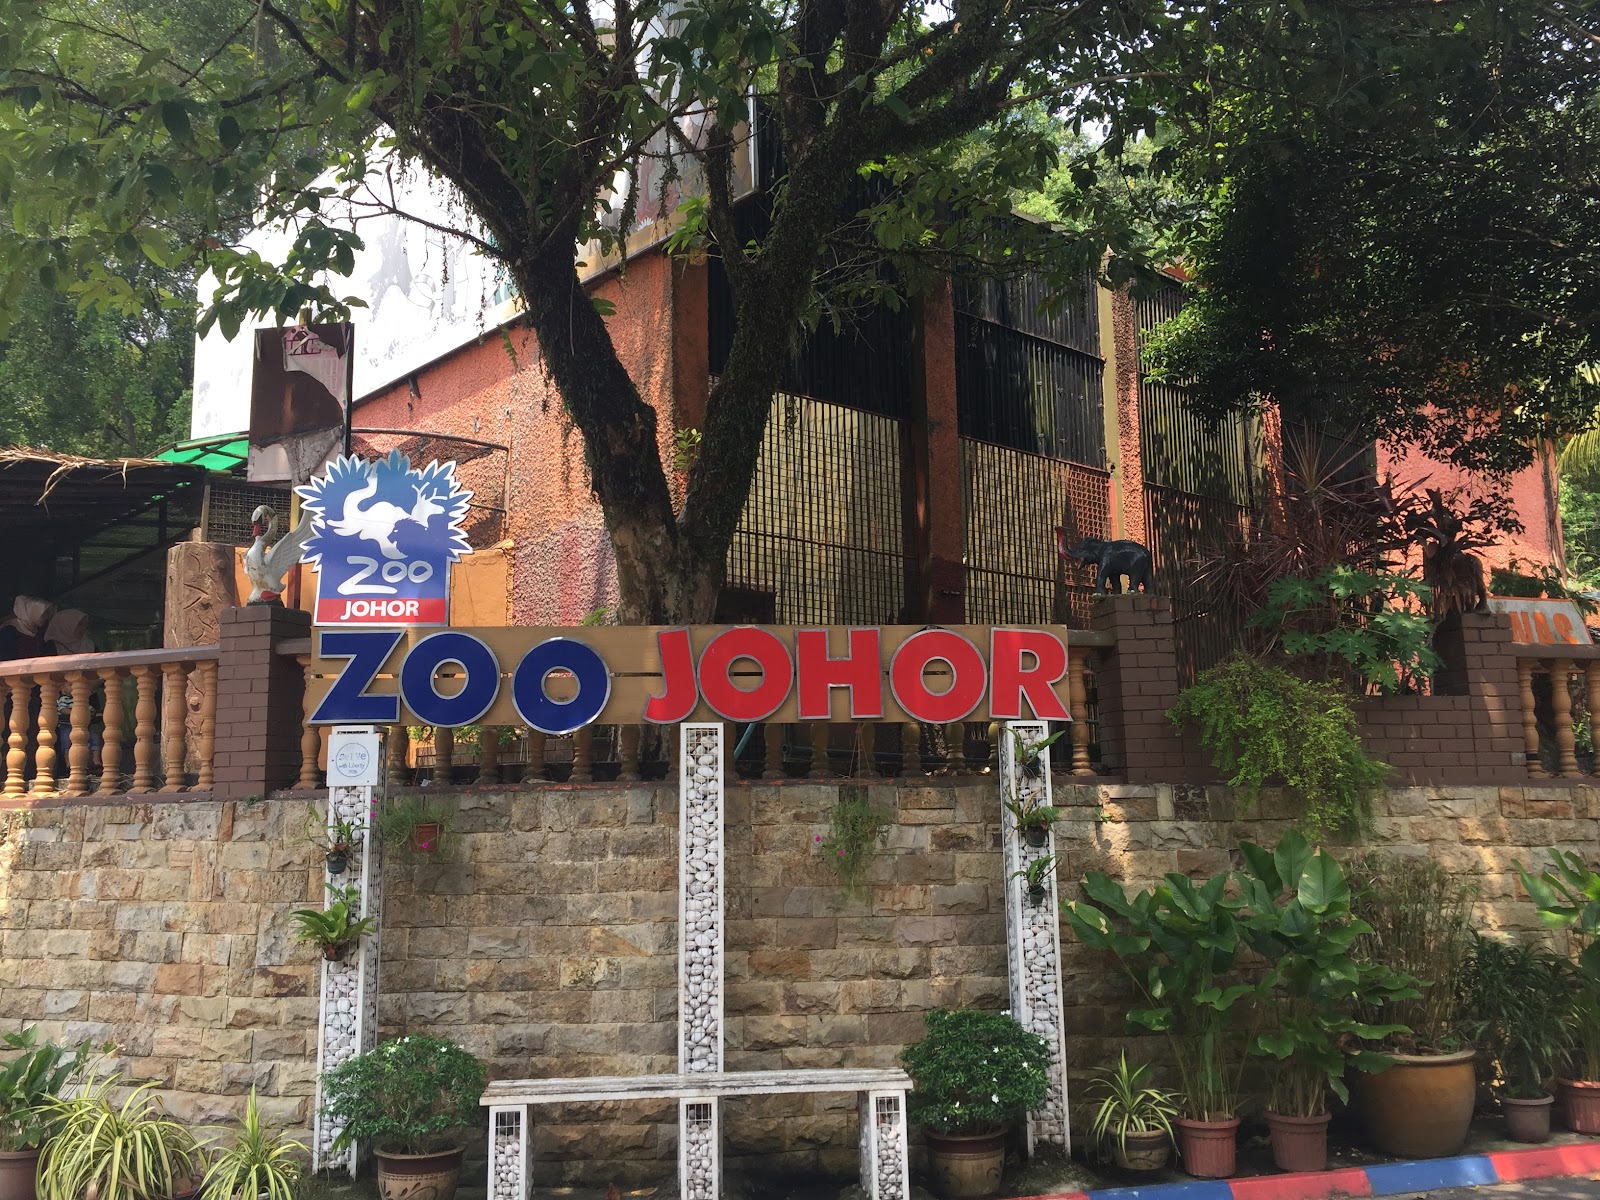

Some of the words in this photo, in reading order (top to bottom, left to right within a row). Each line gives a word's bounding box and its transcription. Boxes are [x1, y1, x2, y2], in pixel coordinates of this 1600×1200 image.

[340, 600, 420, 621] JOHOR
[307, 630, 612, 735] ZOO
[642, 626, 1073, 725] JOHOR
